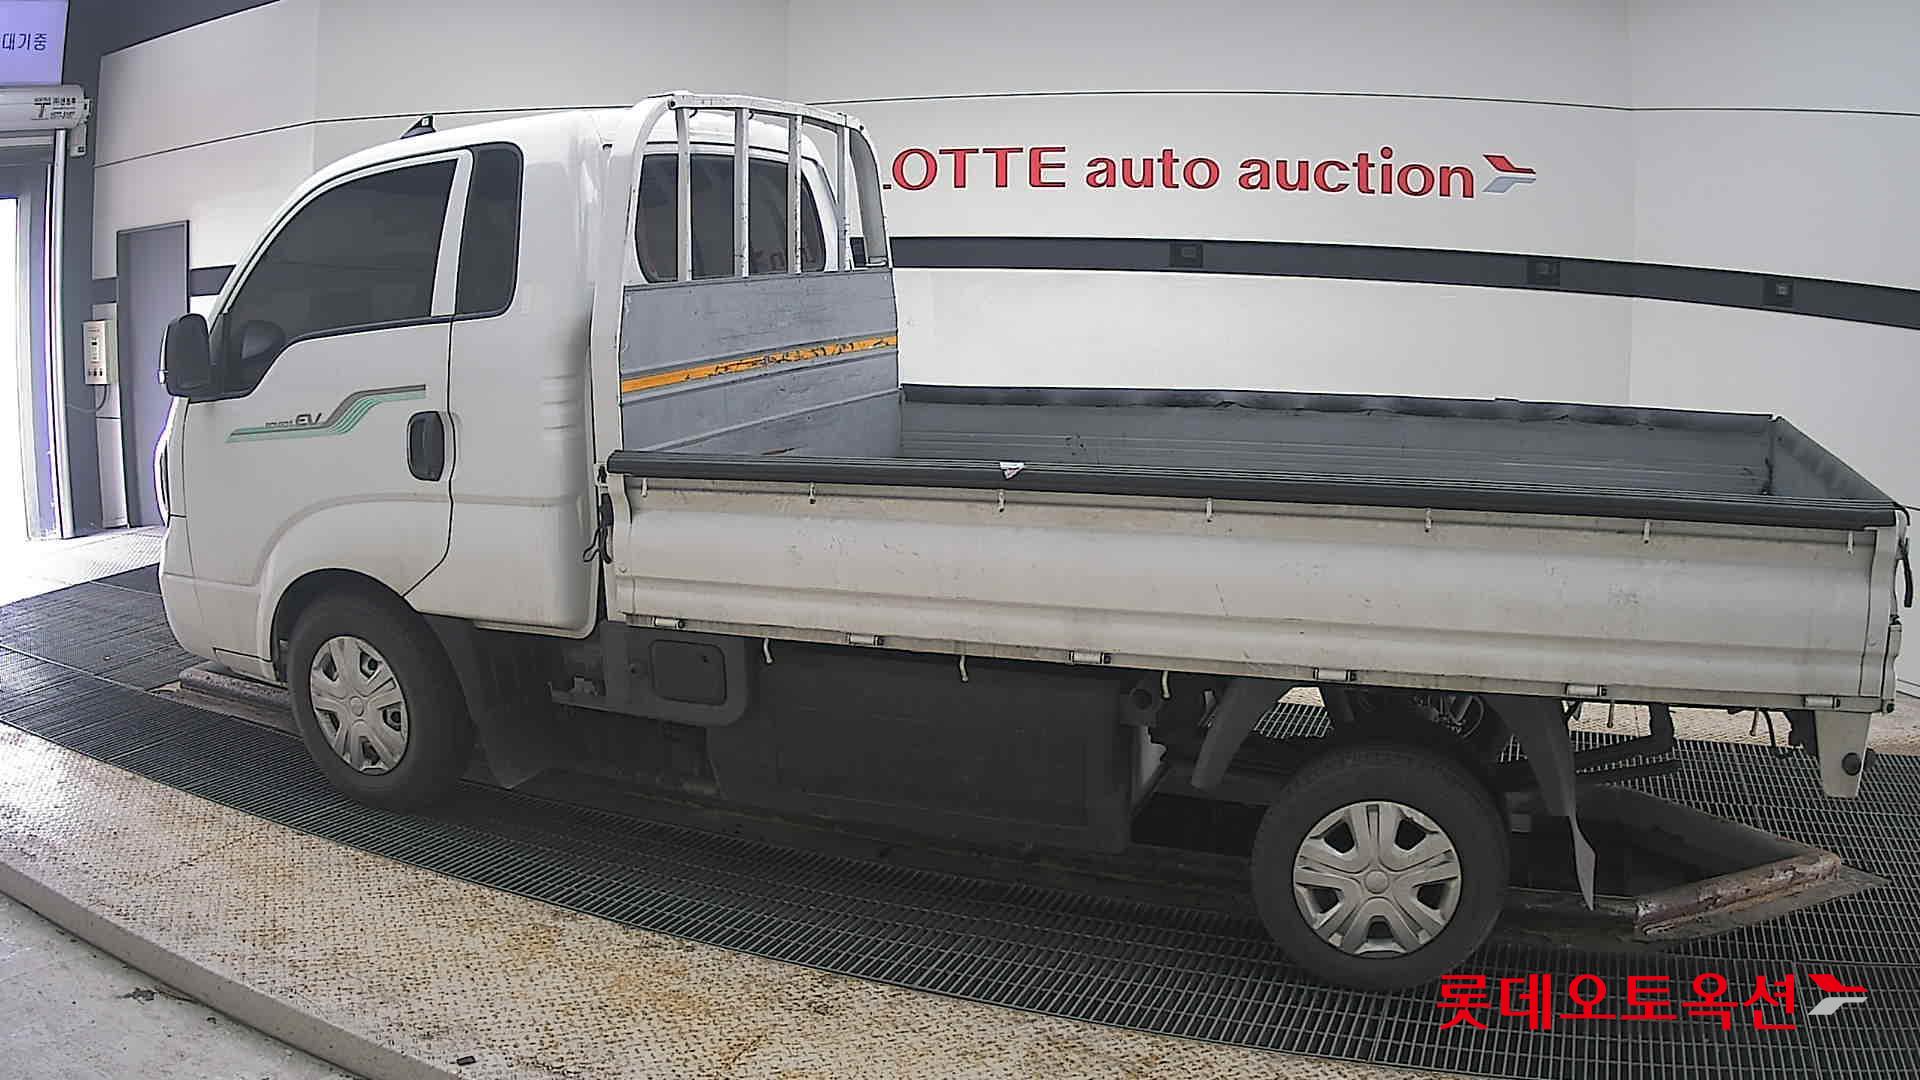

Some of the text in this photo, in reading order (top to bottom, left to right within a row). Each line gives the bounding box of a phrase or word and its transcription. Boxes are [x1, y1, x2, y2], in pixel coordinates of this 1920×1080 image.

[883, 146, 1474, 198] OTTE auto auction
[295, 412, 322, 426] EV
